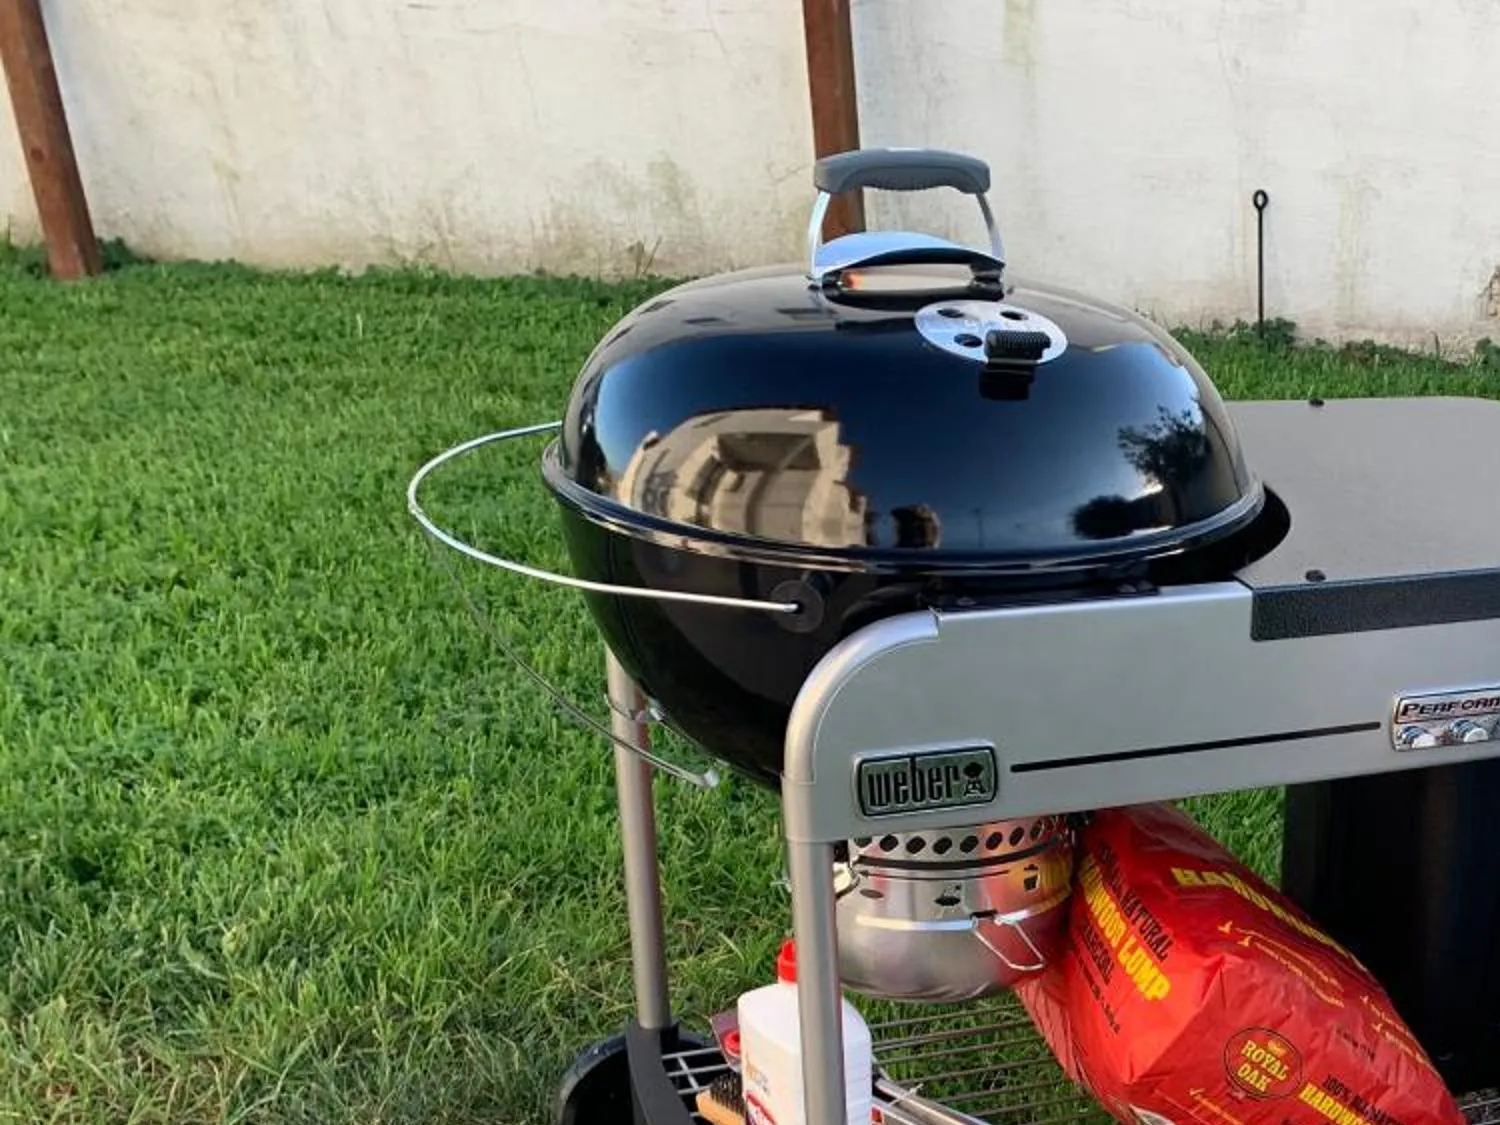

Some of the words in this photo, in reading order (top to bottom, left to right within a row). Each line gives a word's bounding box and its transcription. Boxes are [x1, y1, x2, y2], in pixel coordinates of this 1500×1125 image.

[867, 755, 961, 807] weber
[1118, 933, 1171, 1000] LUMP
[1238, 1063, 1272, 1093] OAK
[1241, 1040, 1289, 1081] ROYAL
